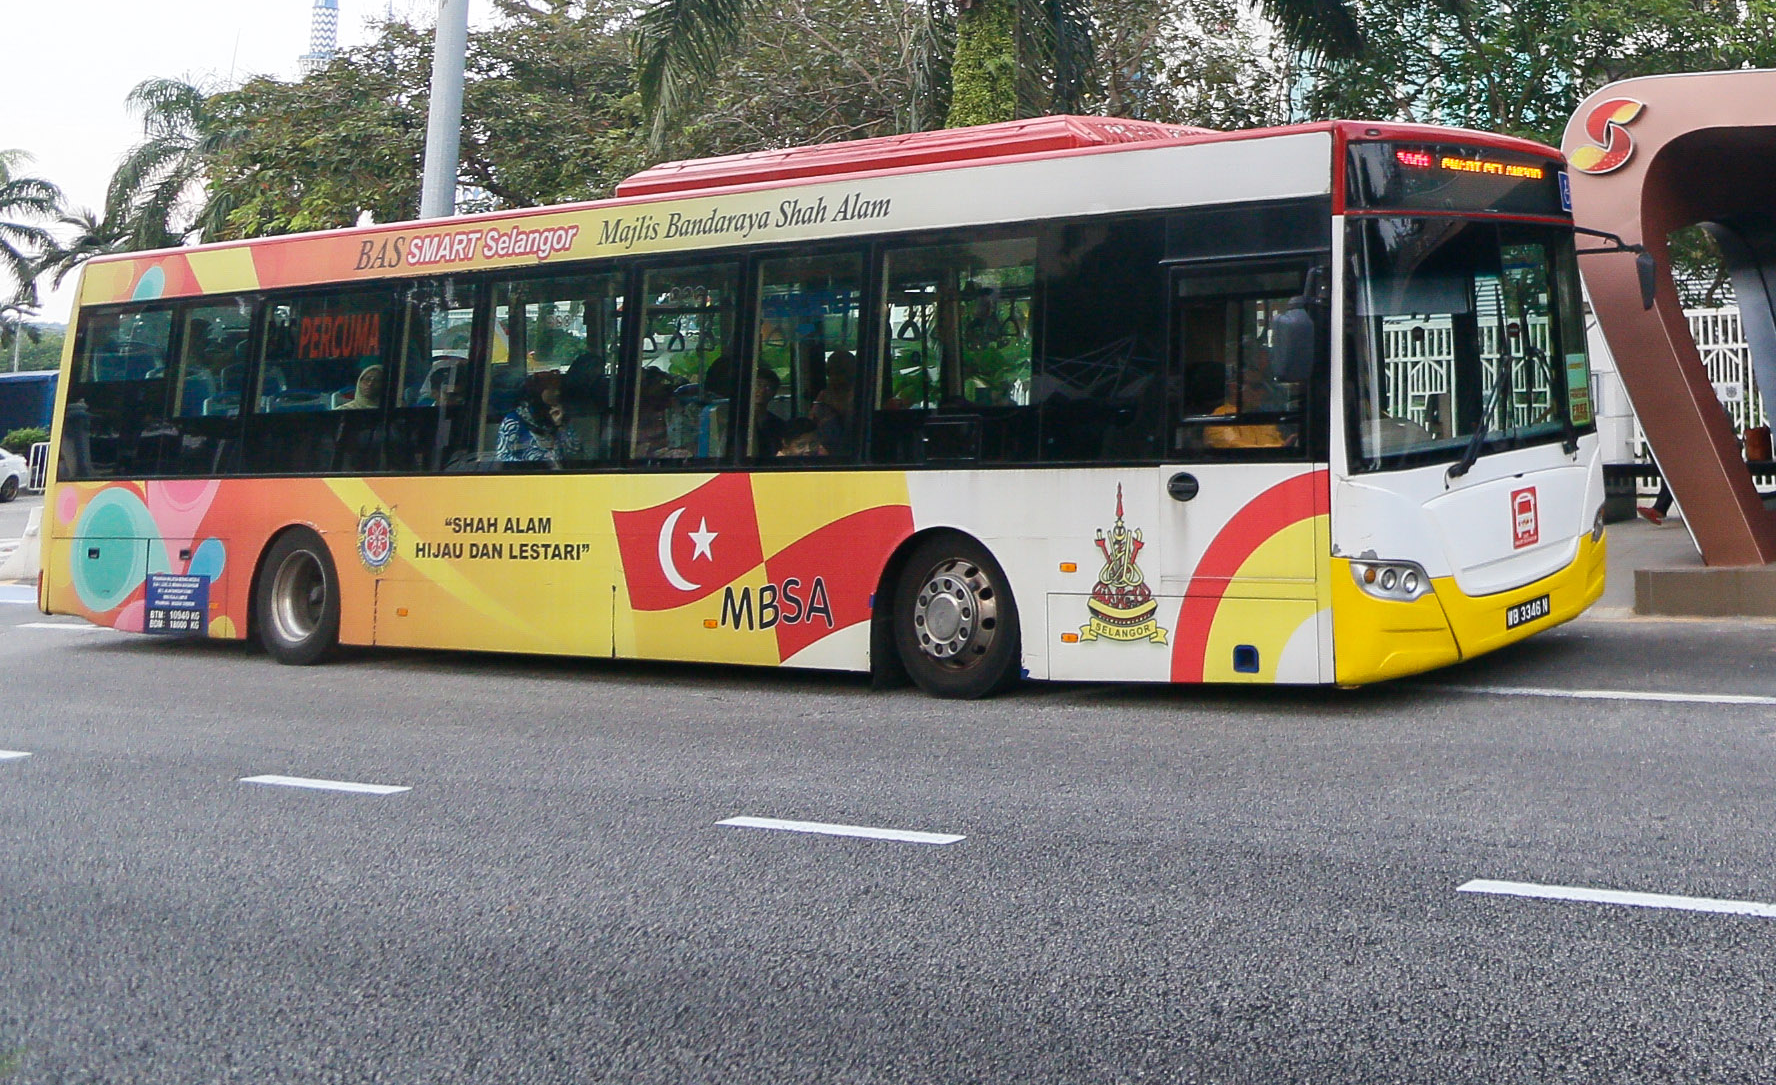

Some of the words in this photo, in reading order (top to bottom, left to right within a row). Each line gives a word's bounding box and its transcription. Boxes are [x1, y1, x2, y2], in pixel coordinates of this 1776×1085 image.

[596, 215, 658, 249] Majlis
[664, 207, 770, 238] Bandaraya
[775, 196, 827, 228] Shah
[831, 192, 891, 222] Alam
[354, 236, 405, 270] BAS
[407, 231, 482, 265] SMART
[483, 227, 578, 260] Selangor
[299, 313, 380, 359] PERCUMA
[503, 517, 551, 534] ALAM
[415, 542, 464, 559] HIJAU
[469, 543, 503, 559] DAN
[720, 576, 834, 631] MBSA
[1520, 600, 1541, 621] 3346
[1542, 597, 1548, 613] N
[170, 610, 190, 620] 10940
[191, 611, 200, 620] KG
[190, 620, 200, 629] KG
[1095, 622, 1151, 638] SELANGOR
